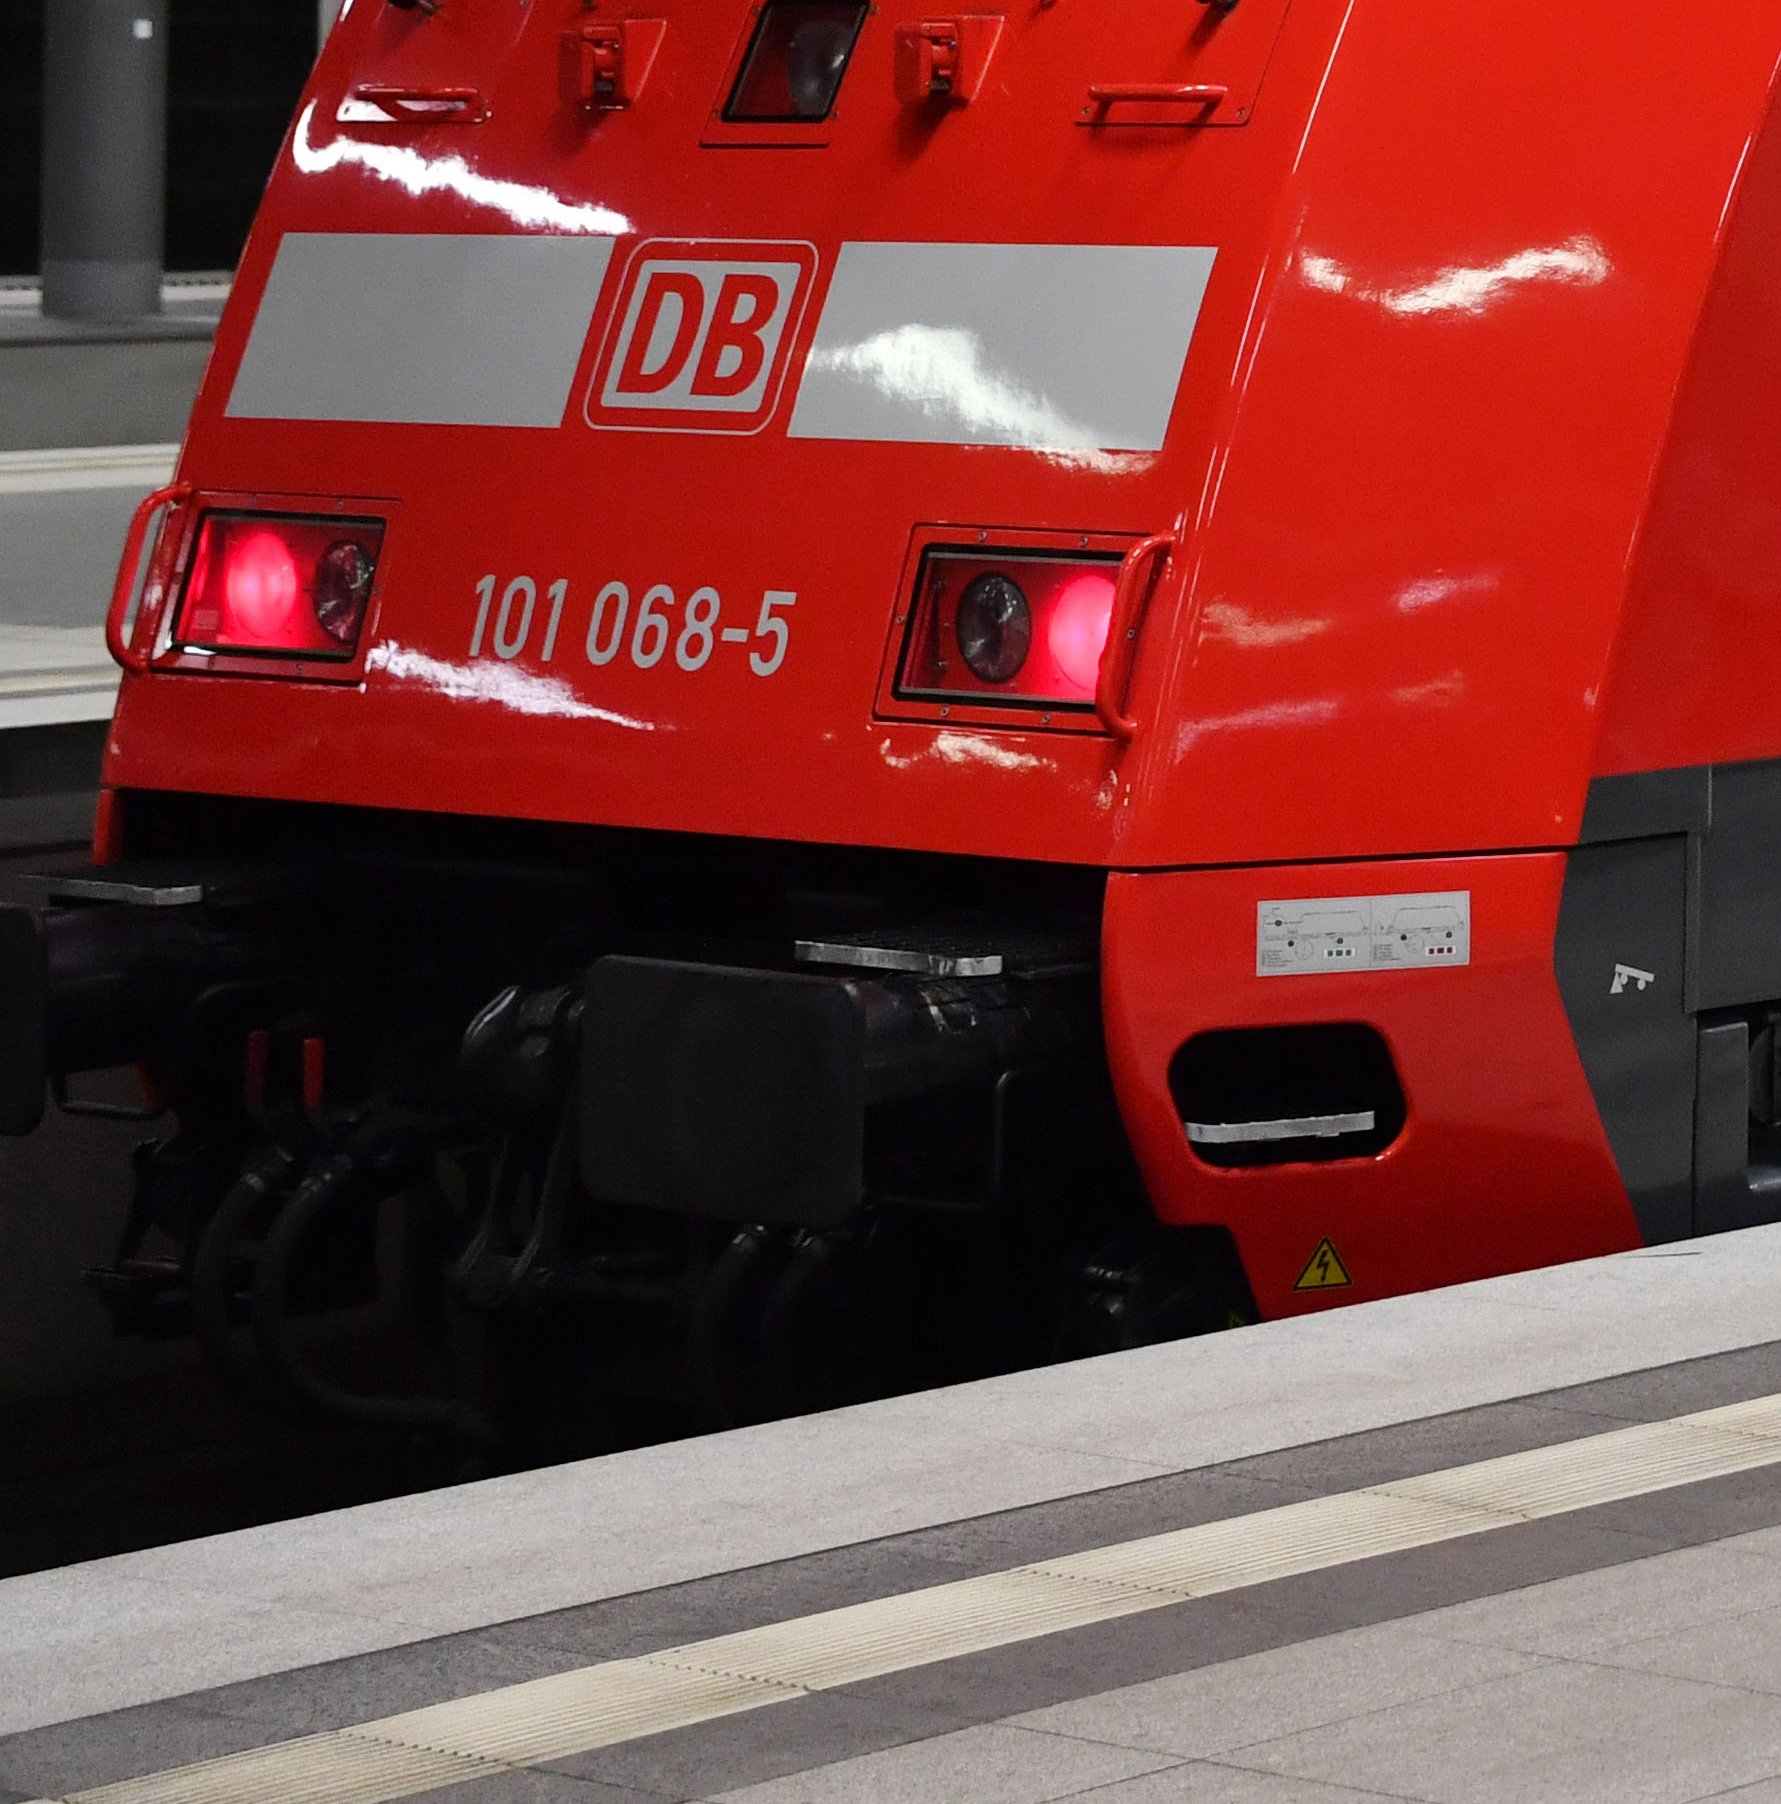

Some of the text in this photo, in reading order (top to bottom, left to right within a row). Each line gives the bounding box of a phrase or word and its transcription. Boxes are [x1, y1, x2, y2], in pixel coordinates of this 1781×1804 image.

[613, 270, 780, 398] DB
[468, 573, 797, 678] 101 068-5
